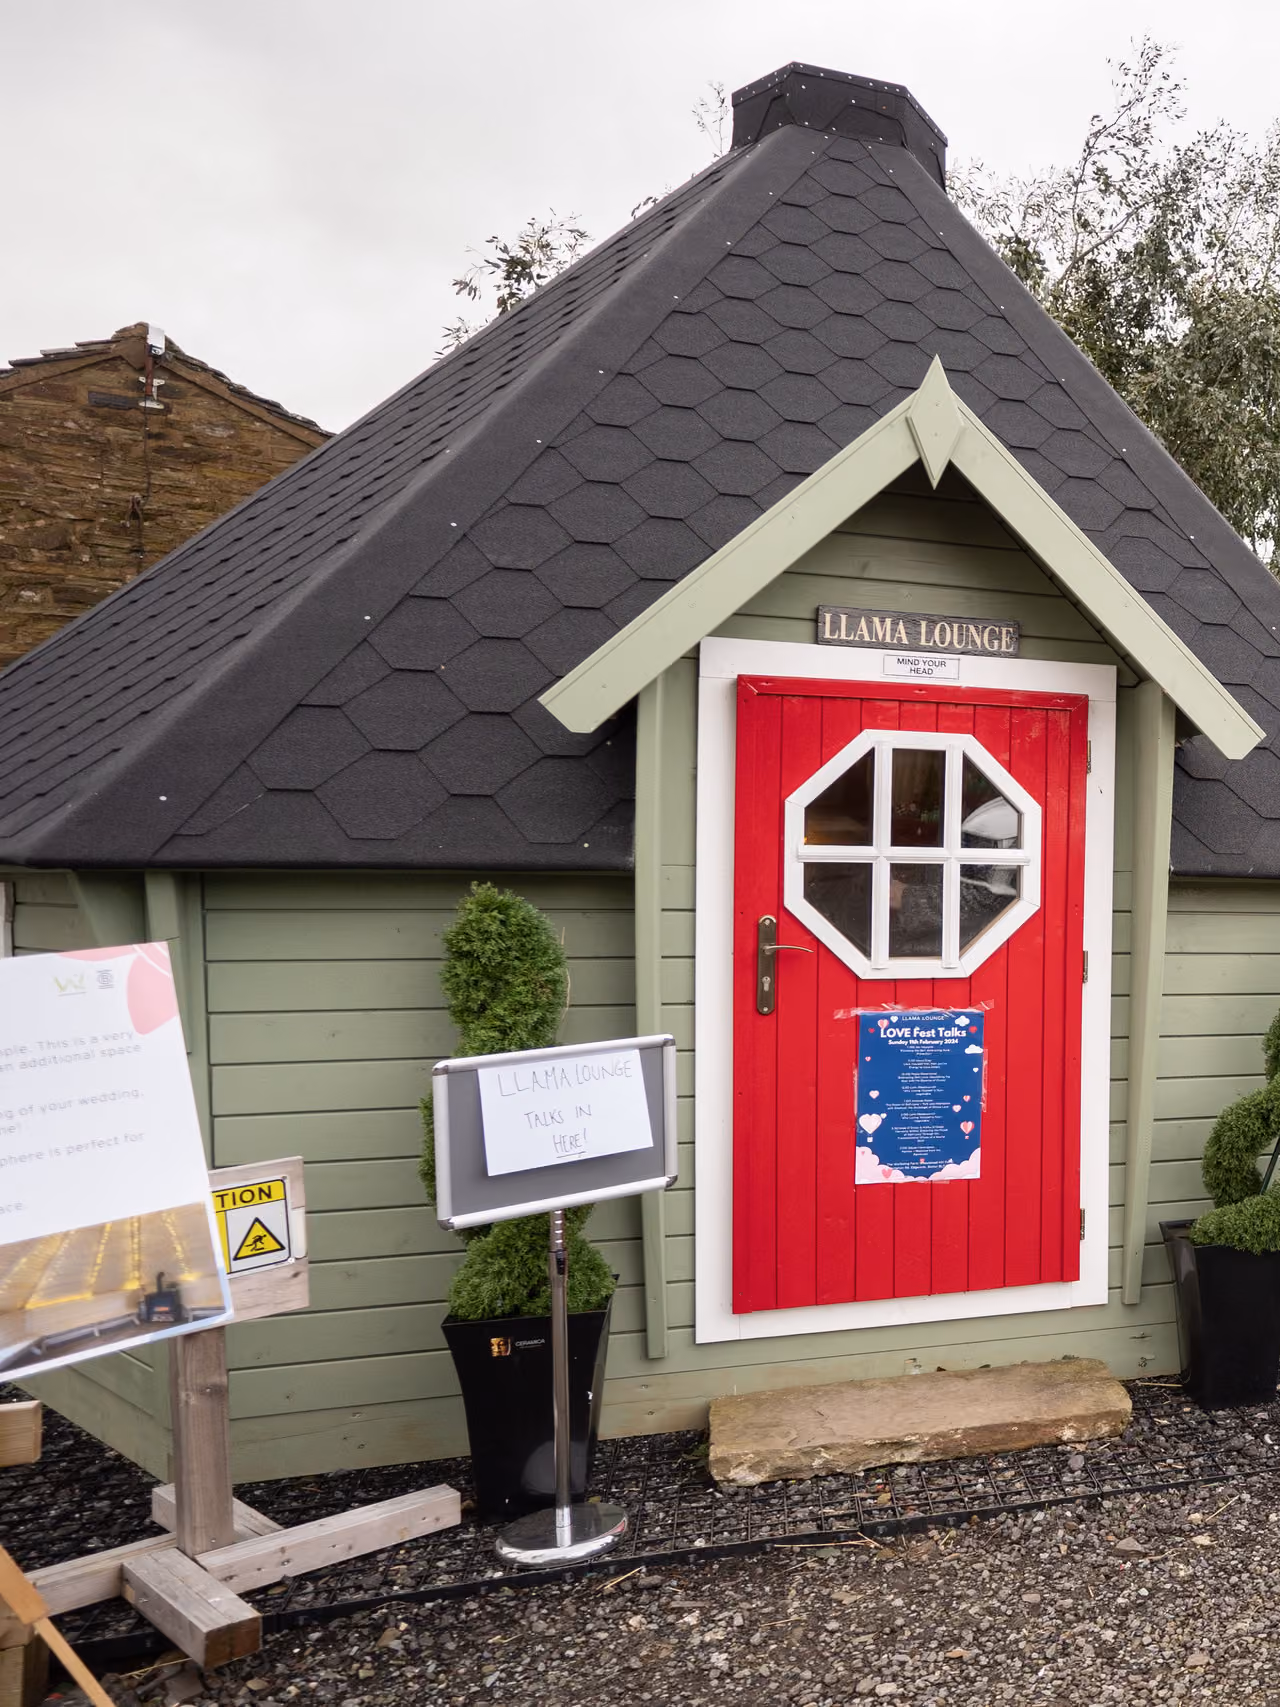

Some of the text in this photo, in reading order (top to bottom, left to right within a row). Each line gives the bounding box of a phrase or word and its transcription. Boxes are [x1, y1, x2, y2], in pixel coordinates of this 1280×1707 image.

[823, 613, 1015, 652] LLAMA LOUNGE
[897, 657, 947, 668] MIND YOUR
[910, 667, 934, 675] HEAD
[880, 1026, 967, 1038] LOVE Fest Talks
[497, 1060, 633, 1097] LLAMA LOUNGE
[524, 1104, 592, 1130] TALKS IN
[553, 1128, 588, 1154] HERE!
